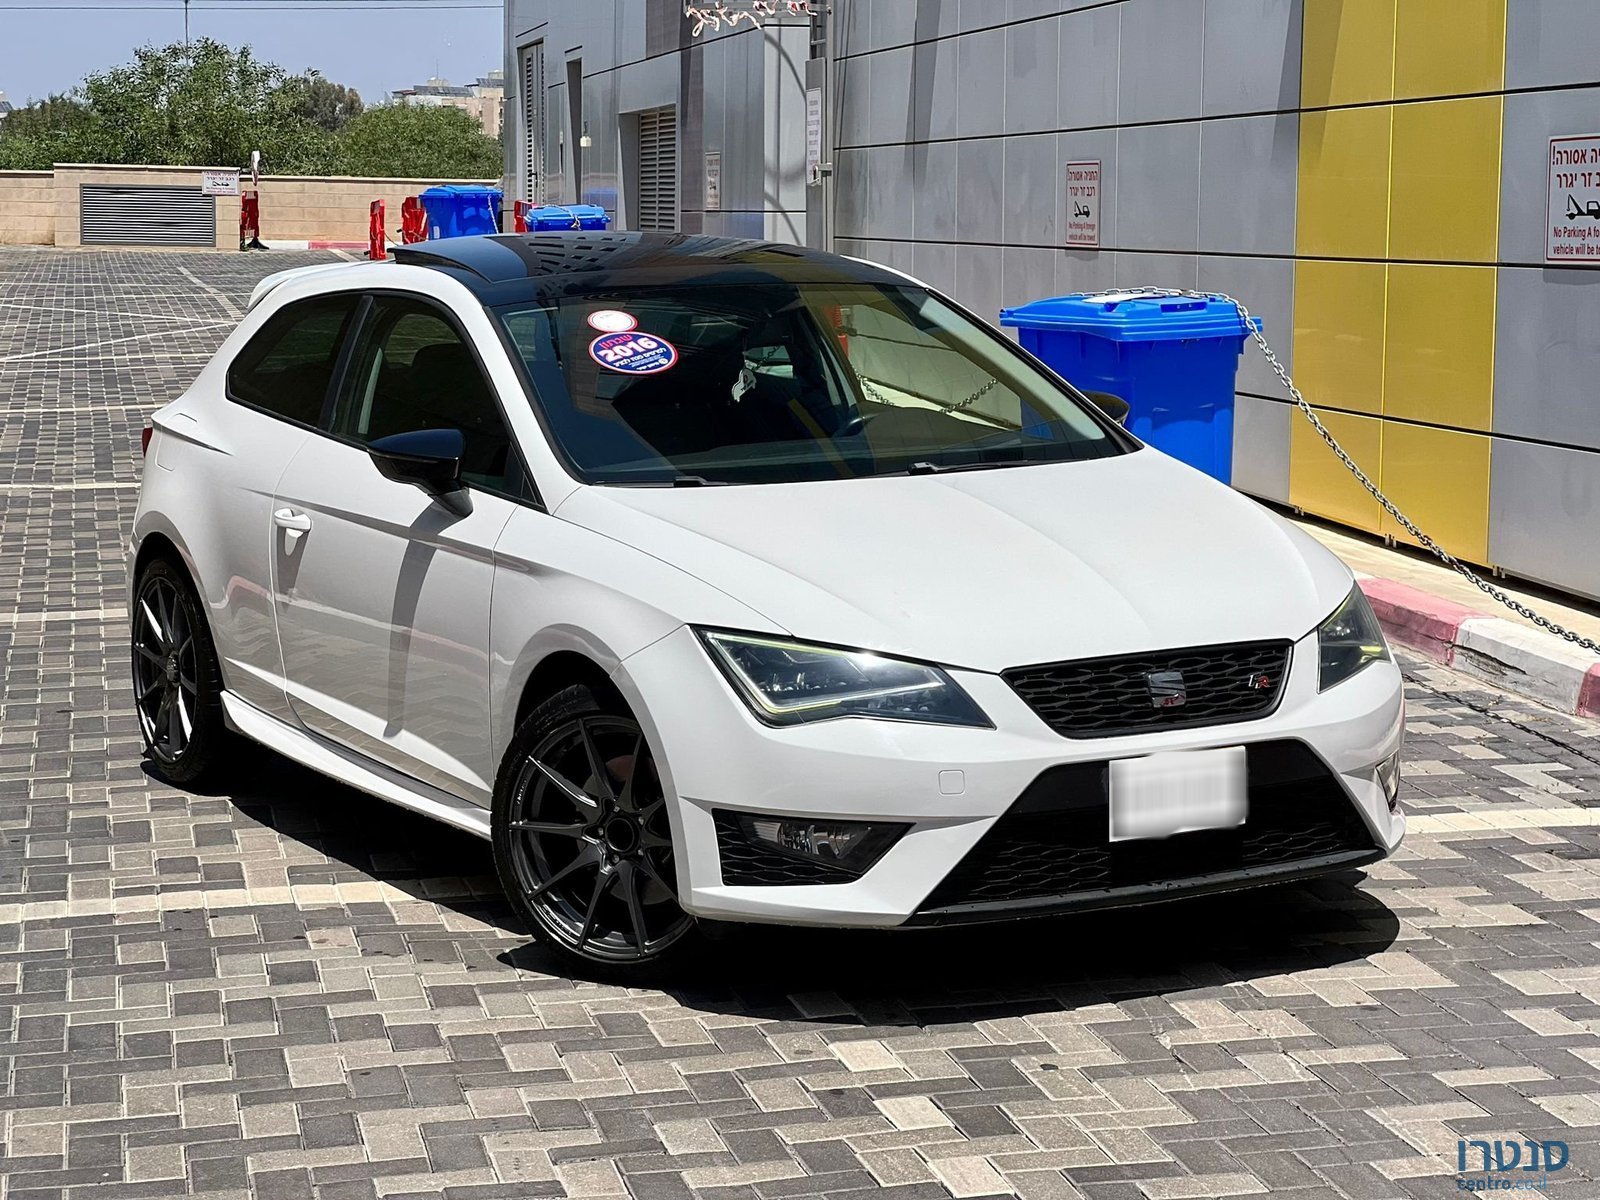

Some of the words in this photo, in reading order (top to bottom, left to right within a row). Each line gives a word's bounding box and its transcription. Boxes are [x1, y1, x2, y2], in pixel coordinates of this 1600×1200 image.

[1552, 145, 1587, 165] אסורה!
[1556, 172, 1578, 189] יגרר
[1581, 172, 1593, 188] זר
[1553, 226, 1562, 238] No
[1563, 226, 1586, 241] Parking
[1587, 226, 1592, 238] A
[1553, 243, 1574, 255] vehicle
[1575, 243, 1586, 255] will
[1587, 243, 1595, 255] be
[597, 337, 658, 362] 2016
